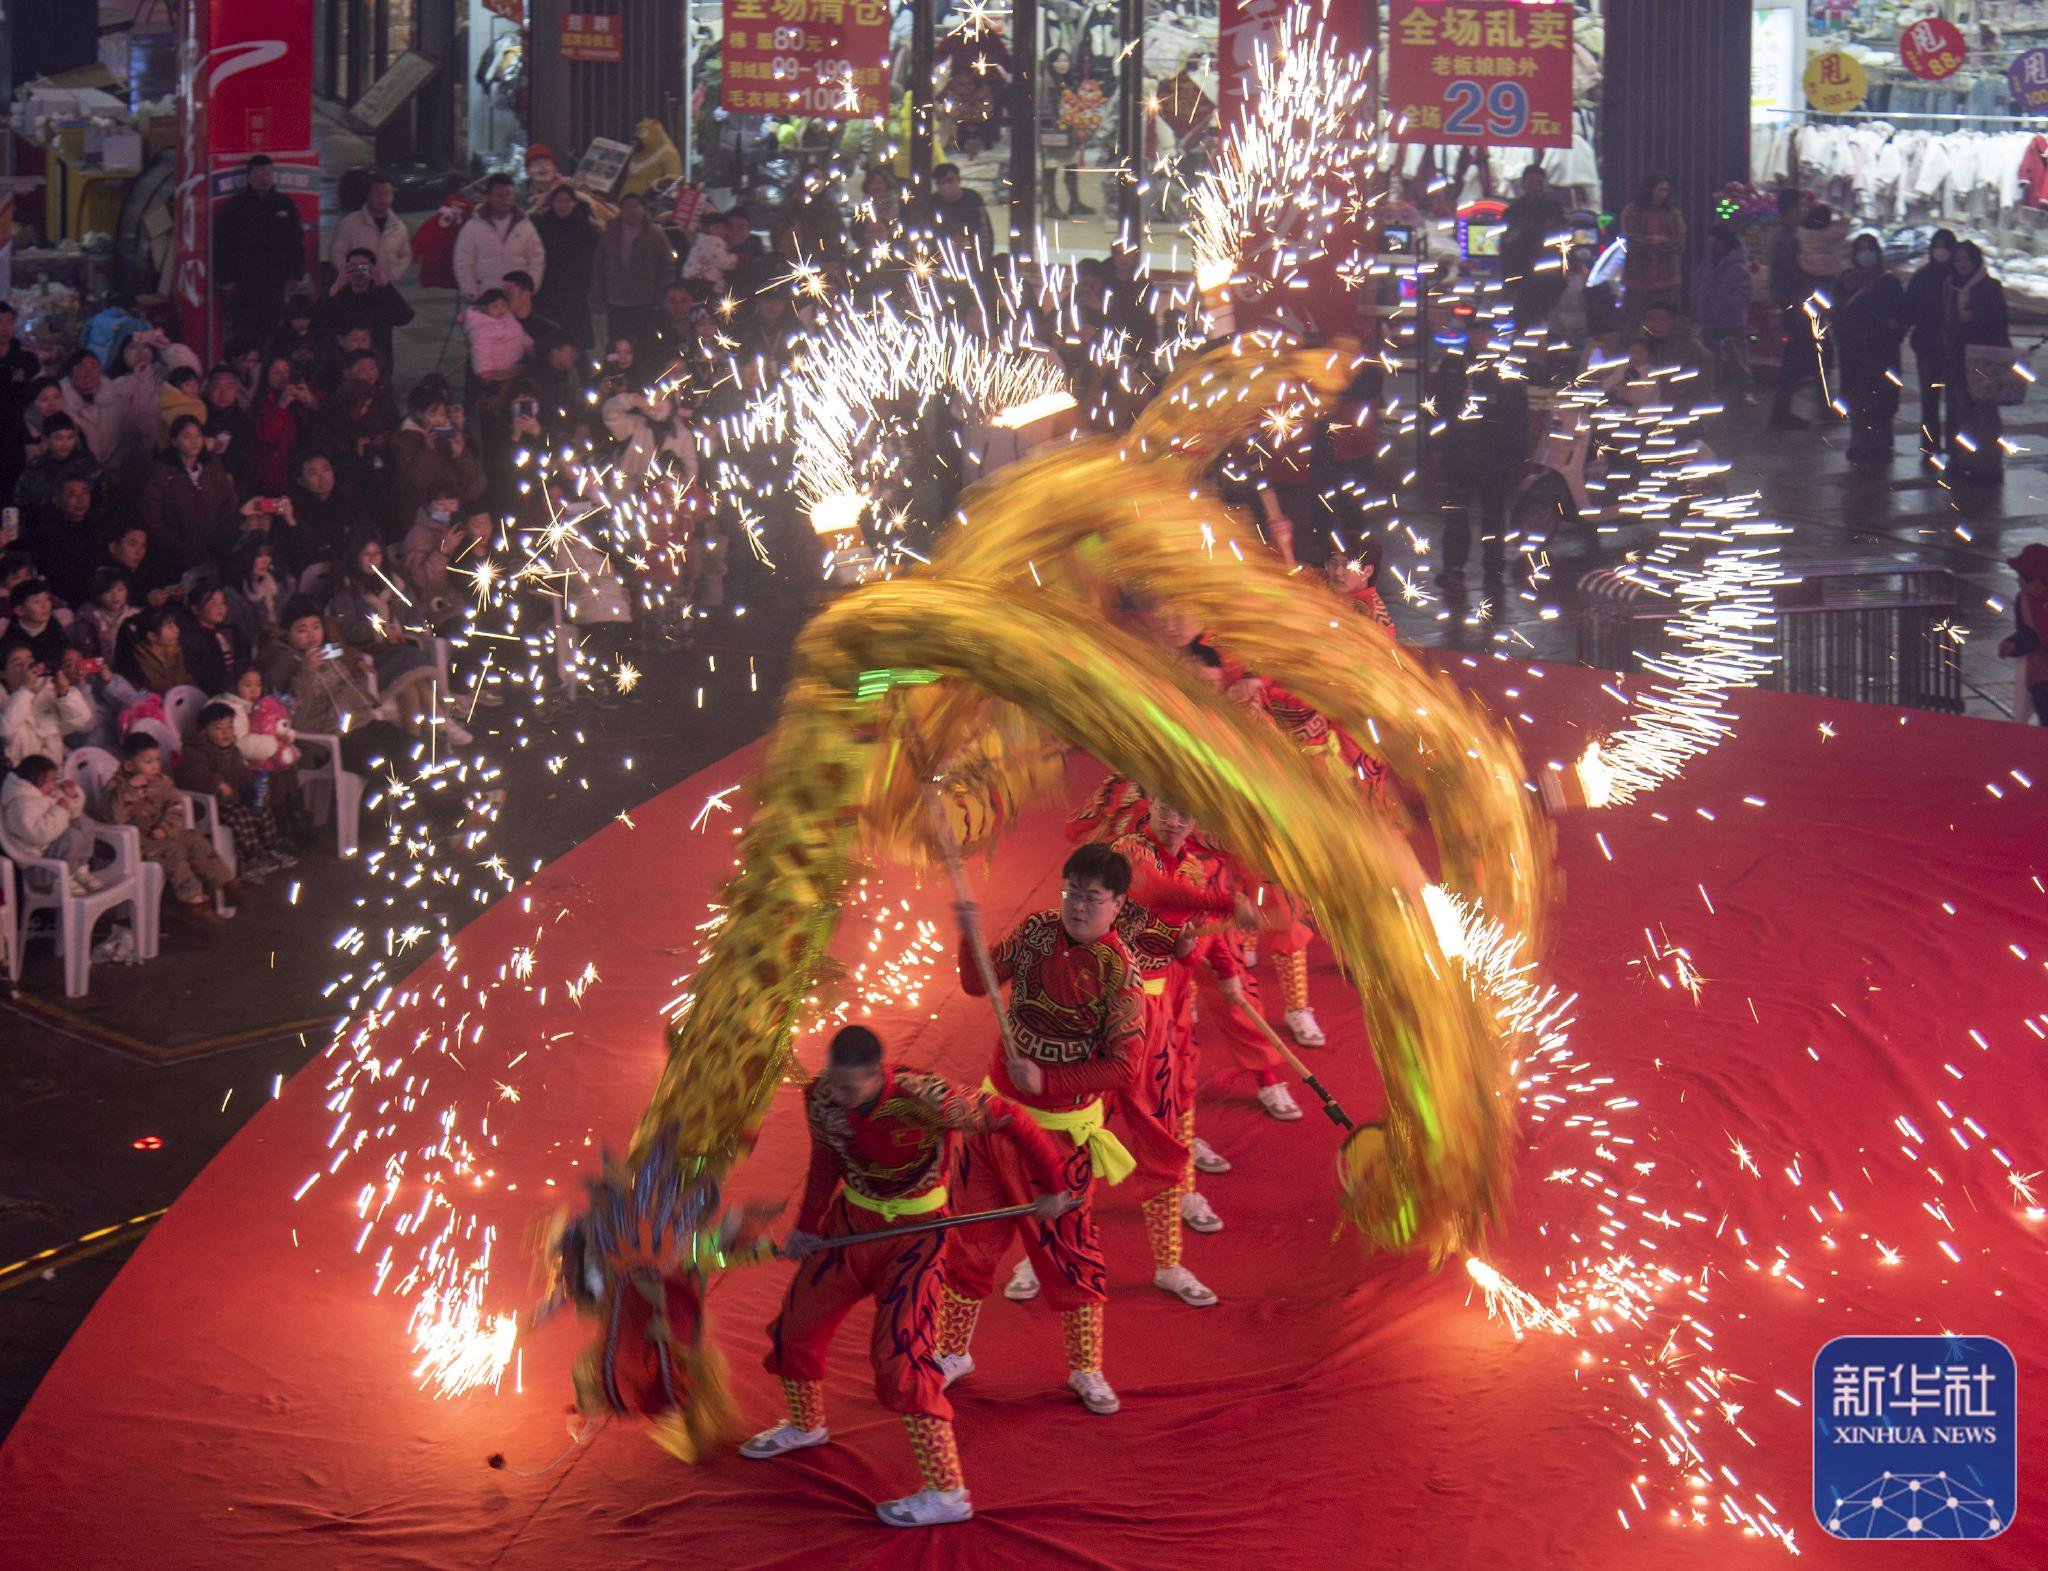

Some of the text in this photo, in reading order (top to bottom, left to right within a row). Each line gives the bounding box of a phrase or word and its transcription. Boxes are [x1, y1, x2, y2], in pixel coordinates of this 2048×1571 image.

[1399, 6, 1568, 49] 全场乱卖
[1910, 21, 1946, 55] 甩
[1430, 55, 1539, 77] 老板娘除外
